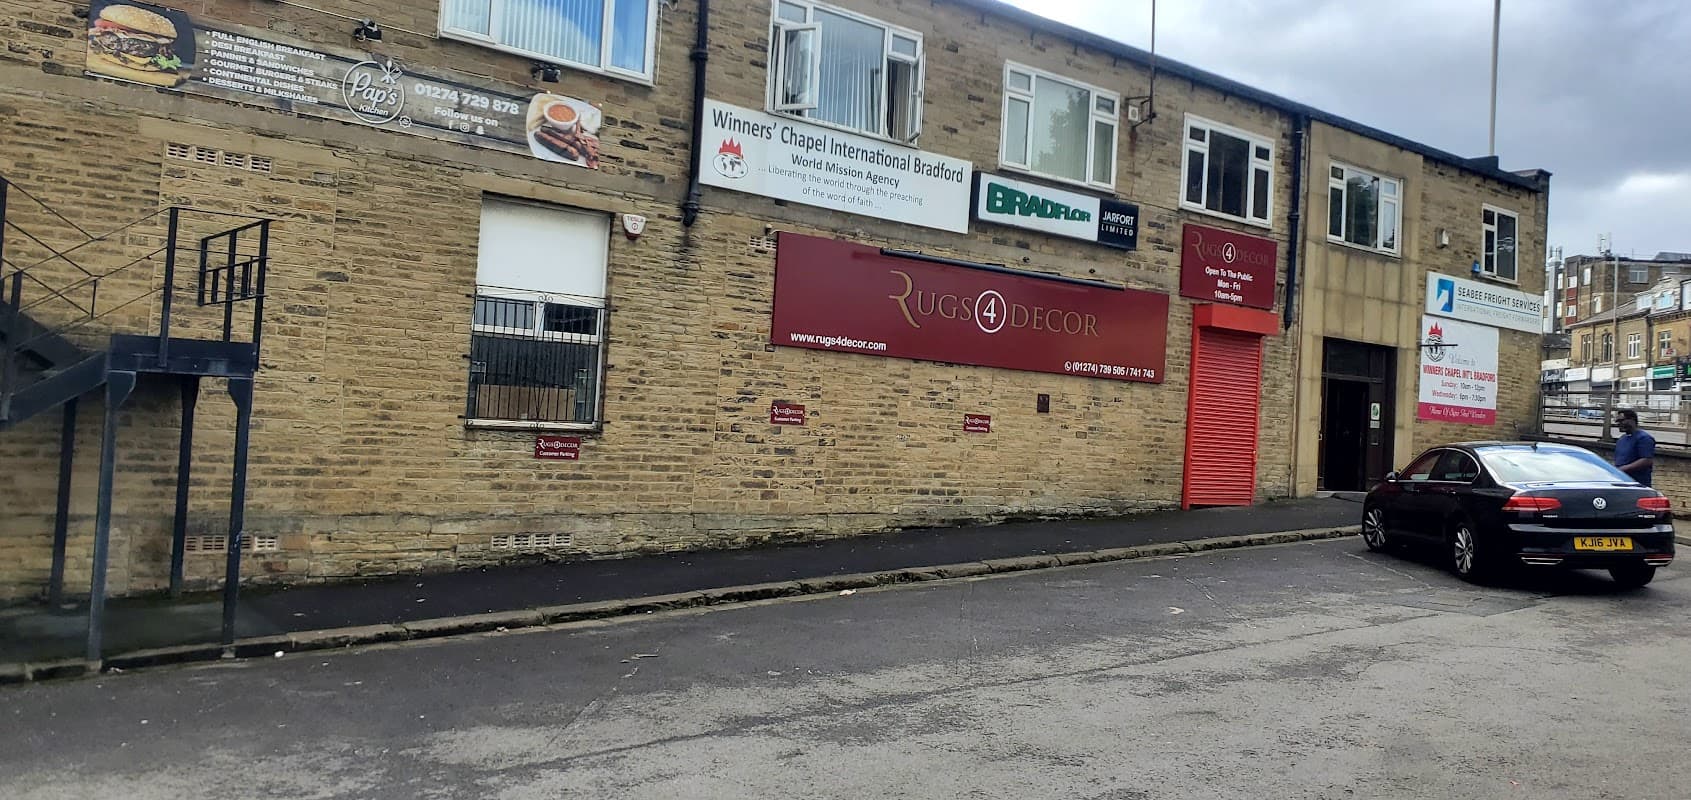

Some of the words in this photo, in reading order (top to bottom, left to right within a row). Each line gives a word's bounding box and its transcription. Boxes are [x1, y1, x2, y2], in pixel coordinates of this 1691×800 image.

[211, 31, 235, 41] FULL
[236, 36, 275, 50] ENGLISH
[275, 44, 326, 60] BREAKFAST
[211, 40, 233, 50] DESI
[234, 45, 286, 60] BREAKFAST
[211, 49, 248, 62] PANINIS
[256, 59, 314, 75] SANDWICHES
[209, 68, 272, 86] CONTINENTAL
[273, 80, 304, 91] DISHES
[210, 59, 255, 73] GOURMET
[255, 67, 297, 81] BURGERS
[305, 77, 338, 89] STEAKS
[209, 77, 254, 90] DESSERTS
[264, 88, 318, 103] MILKSHAKES
[350, 71, 398, 107] Pap's
[415, 83, 459, 102] 01274
[461, 92, 490, 109] 729
[492, 99, 519, 115] 878
[358, 103, 389, 116] Kitchen
[434, 106, 469, 121] Follow
[471, 114, 484, 124] us
[485, 118, 499, 127] on
[781, 126, 826, 153] Chapel
[830, 137, 910, 172] International
[914, 157, 964, 184] Bradford
[791, 153, 823, 170] World
[825, 161, 863, 179] Mission
[866, 170, 900, 188] Agency
[768, 164, 807, 183] Liberating
[809, 174, 822, 184] the
[823, 178, 845, 189] world
[846, 182, 875, 196] through
[876, 188, 888, 198] the
[889, 192, 923, 206] preaching
[802, 187, 811, 195] of
[812, 189, 825, 199] the
[826, 192, 846, 203] word
[847, 195, 856, 204] of
[857, 198, 873, 207] faith
[986, 182, 1091, 222] BRADFLOR
[1103, 210, 1134, 226] JARFORT
[1101, 223, 1134, 237] LIMITED
[1205, 266, 1219, 277] Open
[1220, 268, 1227, 277] To
[1228, 270, 1237, 279] The
[1237, 272, 1254, 282] Public
[1217, 280, 1230, 289] Mon
[1233, 282, 1241, 291] Fri
[1458, 286, 1483, 300] SEABEE
[1484, 292, 1511, 307] FREIGHT
[1512, 298, 1541, 313] SERVICES
[791, 332, 887, 351] www.rugs4decor.com
[1072, 361, 1098, 375] (01274)
[1099, 364, 1112, 374] 739
[1112, 366, 1125, 376] 505
[1130, 367, 1142, 377] 741
[1143, 368, 1155, 378] 743
[1444, 367, 1461, 378] CHAPEL
[1473, 371, 1496, 383] BRADFORD
[1580, 538, 1604, 548] KJ16
[1606, 538, 1626, 548] JVA
